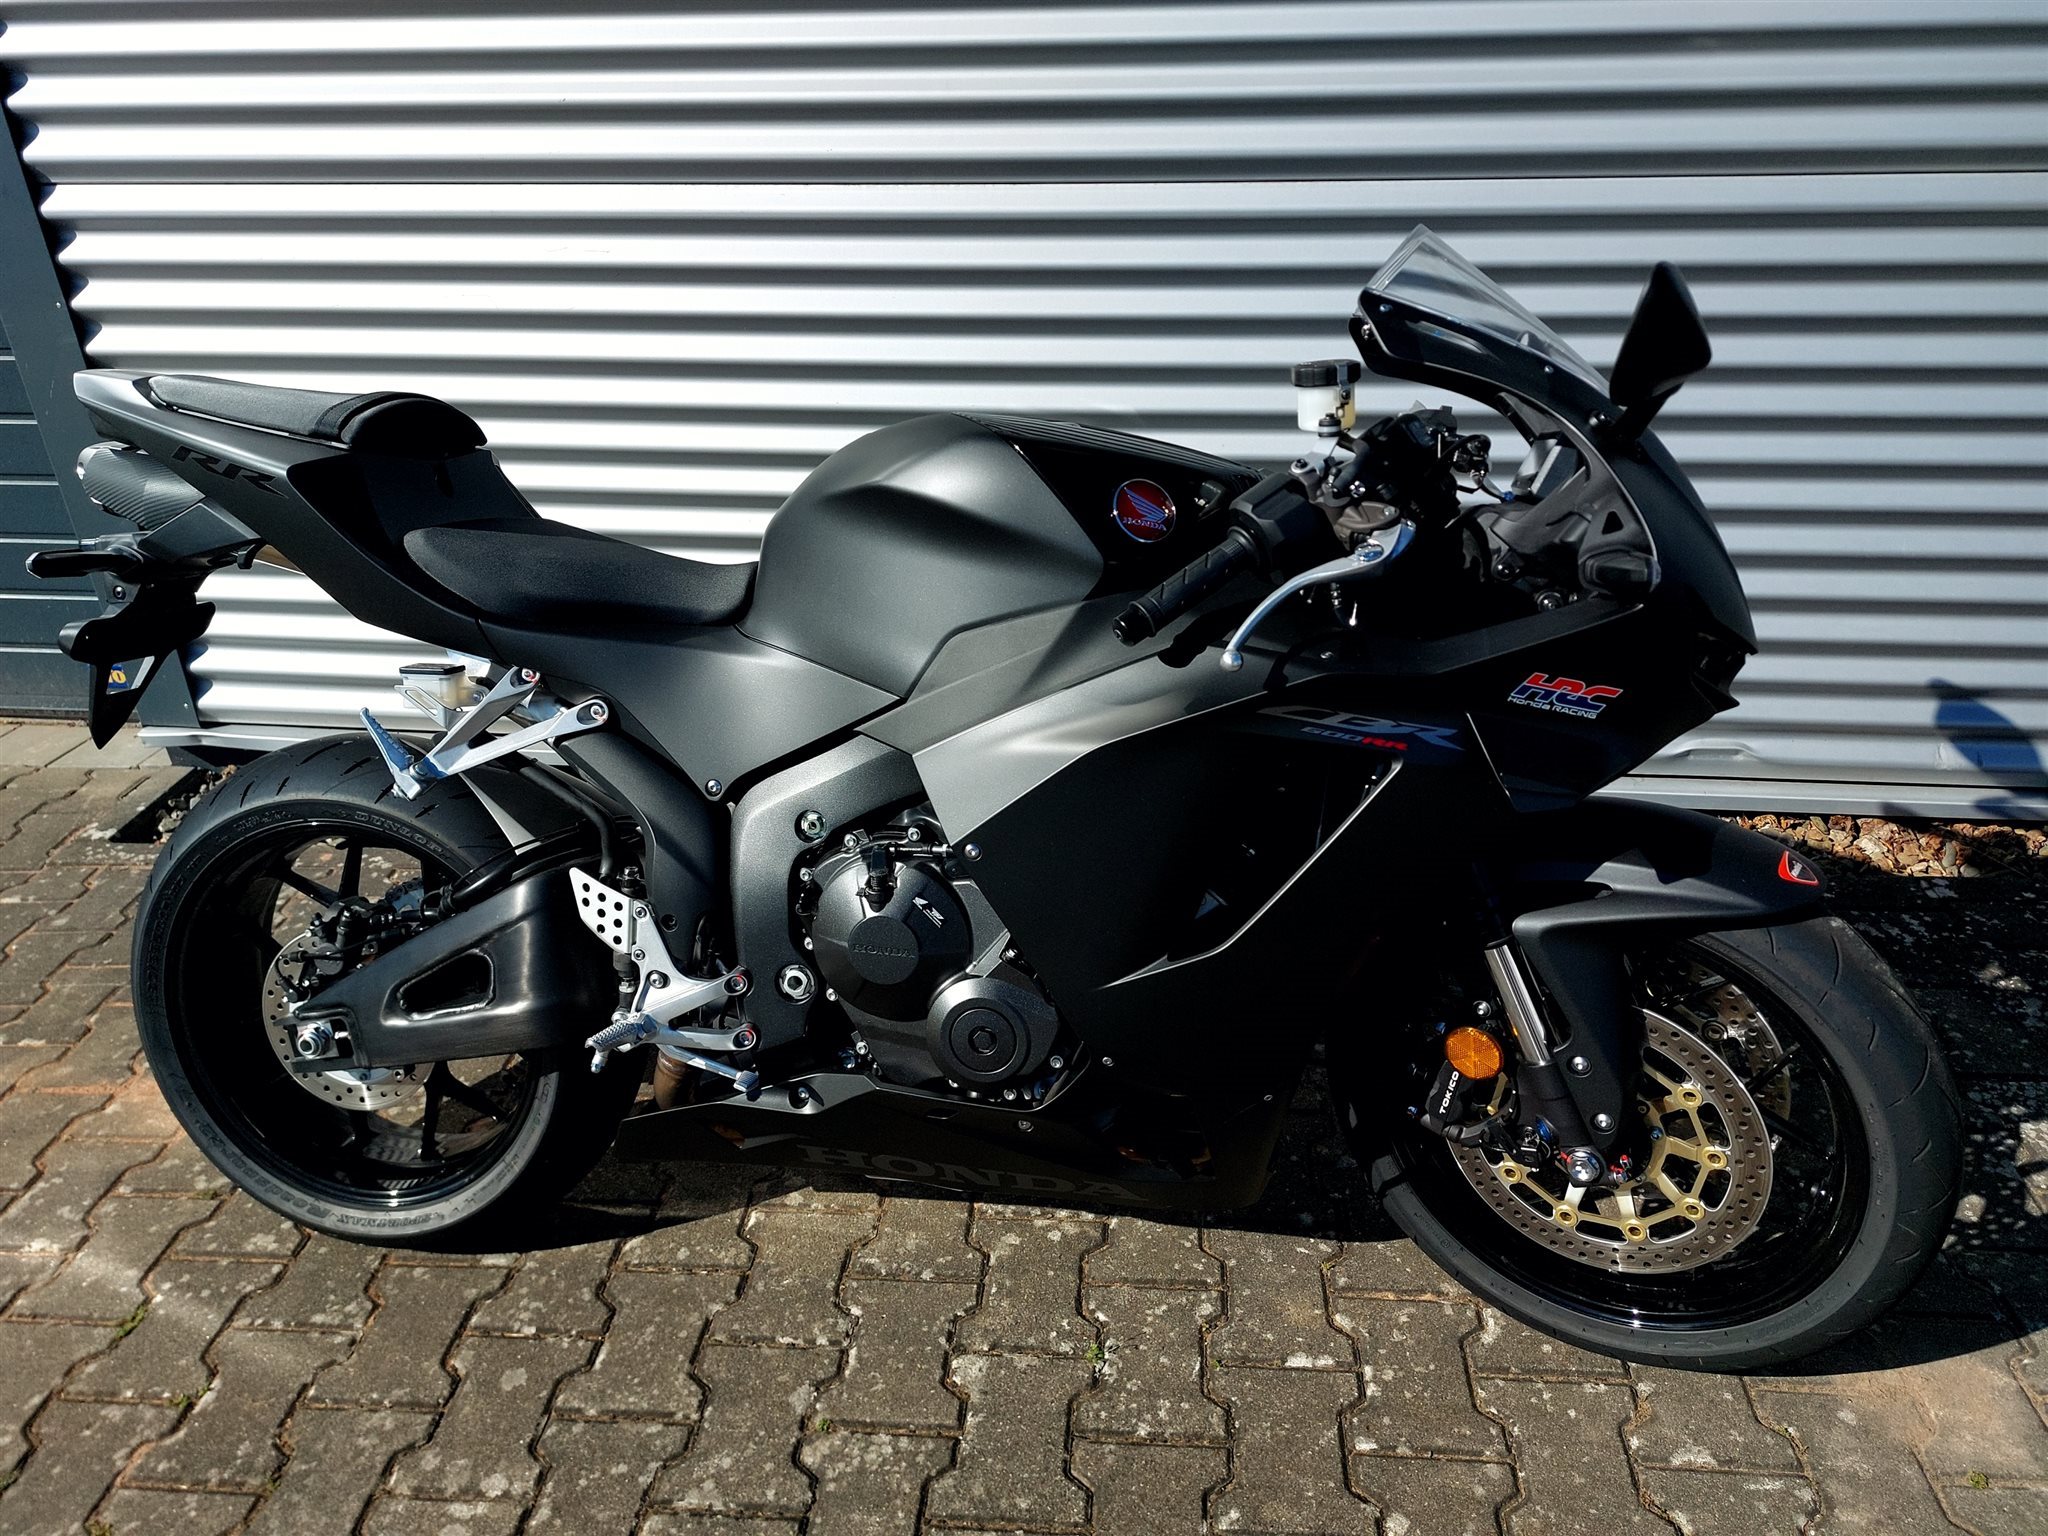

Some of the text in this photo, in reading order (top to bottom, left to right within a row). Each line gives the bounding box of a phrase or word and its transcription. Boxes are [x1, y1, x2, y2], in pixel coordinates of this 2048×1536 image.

[1123, 517, 1167, 531] HONDA
[1507, 696, 1598, 719] Honda RACING
[1510, 672, 1624, 713] HRC
[354, 811, 449, 860] DUNLOP
[852, 943, 916, 958] HONDA
[1439, 1070, 1460, 1114] TOKICO
[797, 1144, 1150, 1201] HONDA
